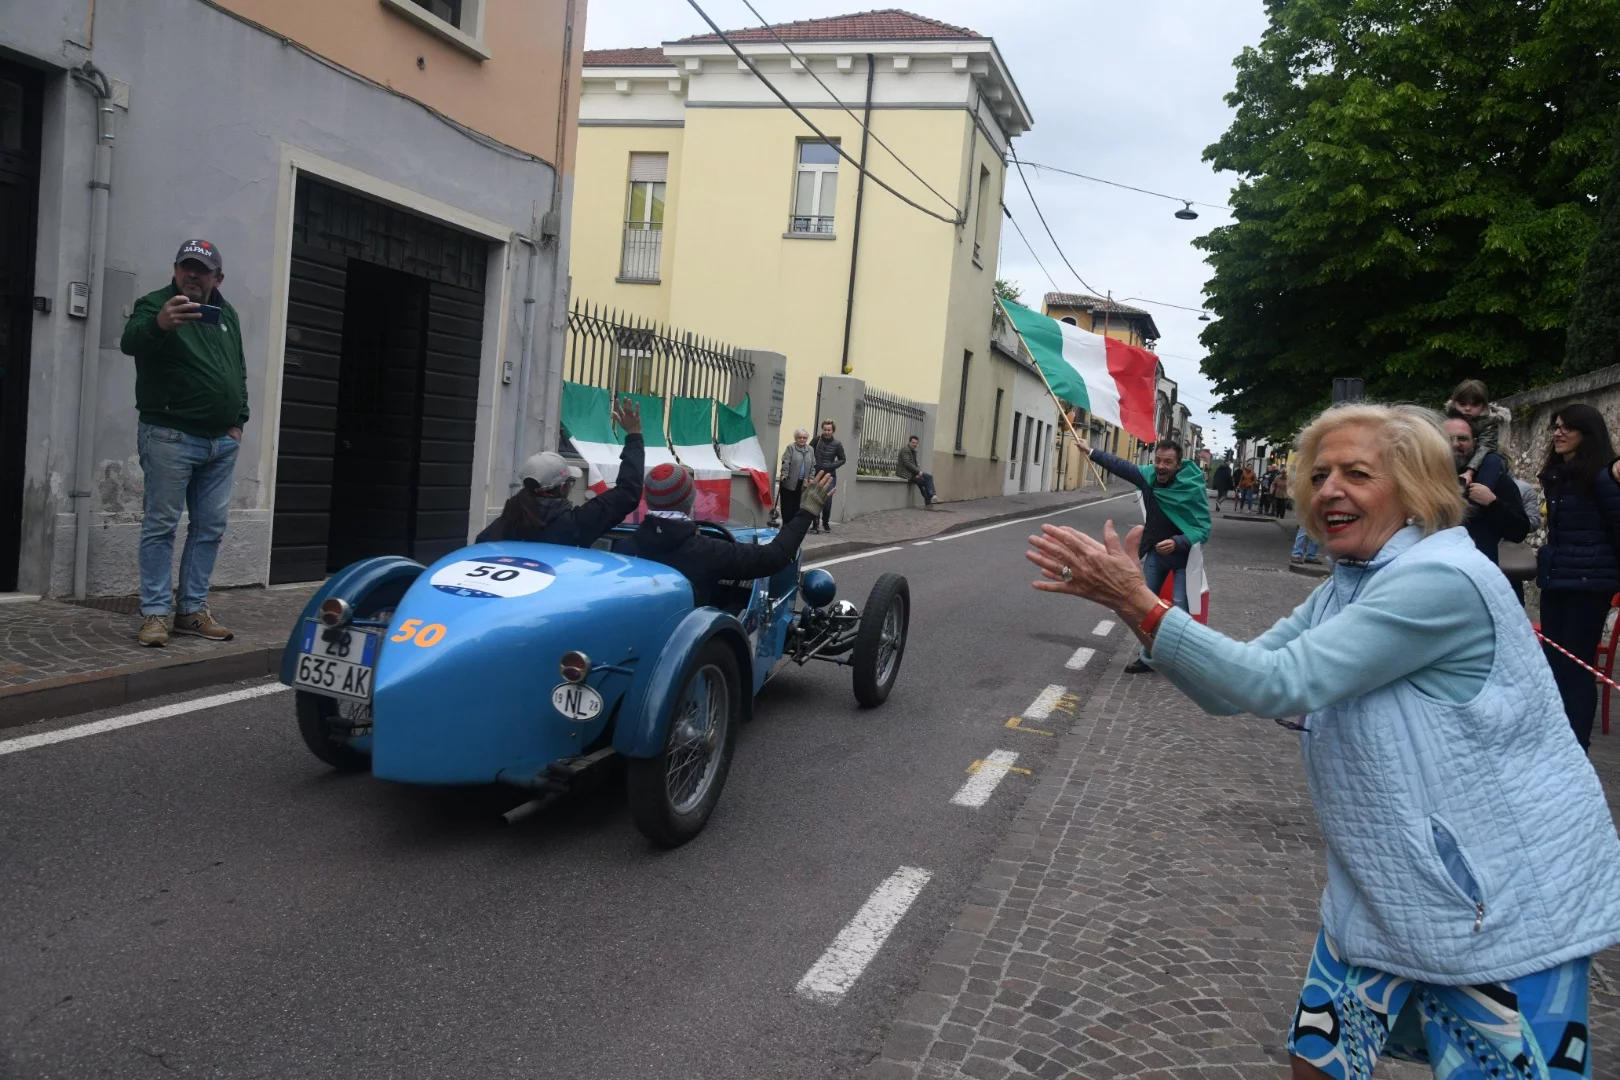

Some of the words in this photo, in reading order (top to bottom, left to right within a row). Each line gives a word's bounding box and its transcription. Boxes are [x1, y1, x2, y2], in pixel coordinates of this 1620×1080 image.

[184, 246, 212, 256] JAPAN
[465, 565, 520, 582] 50
[391, 618, 447, 648] 50
[299, 656, 338, 687] 635
[342, 666, 370, 696] AK
[564, 689, 587, 716] NL
